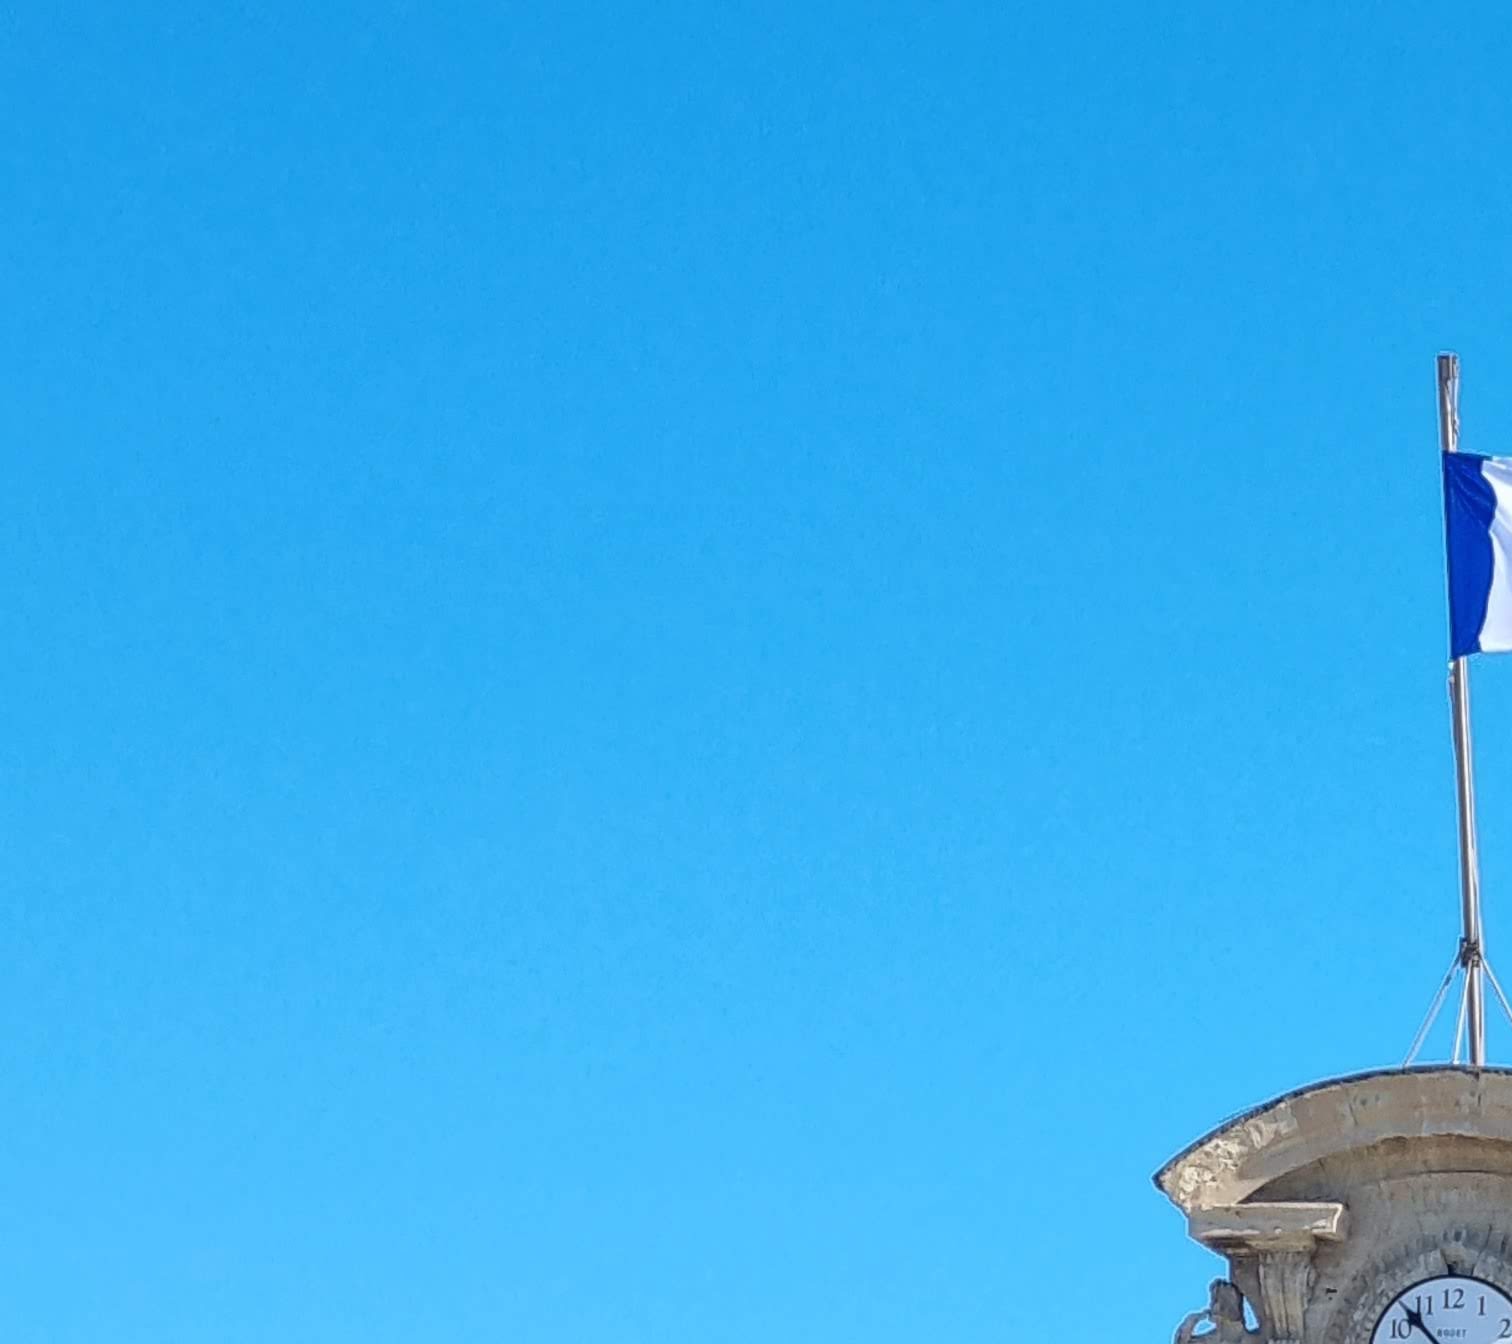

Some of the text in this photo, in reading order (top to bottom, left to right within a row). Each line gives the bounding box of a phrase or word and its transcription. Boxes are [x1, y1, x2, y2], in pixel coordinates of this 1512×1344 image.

[1415, 1295, 1433, 1315] 11
[1442, 1288, 1465, 1309] 12
[1478, 1296, 1485, 1316] 1
[1390, 1319, 1412, 1339] 10
[1498, 1318, 1511, 1338] 2
